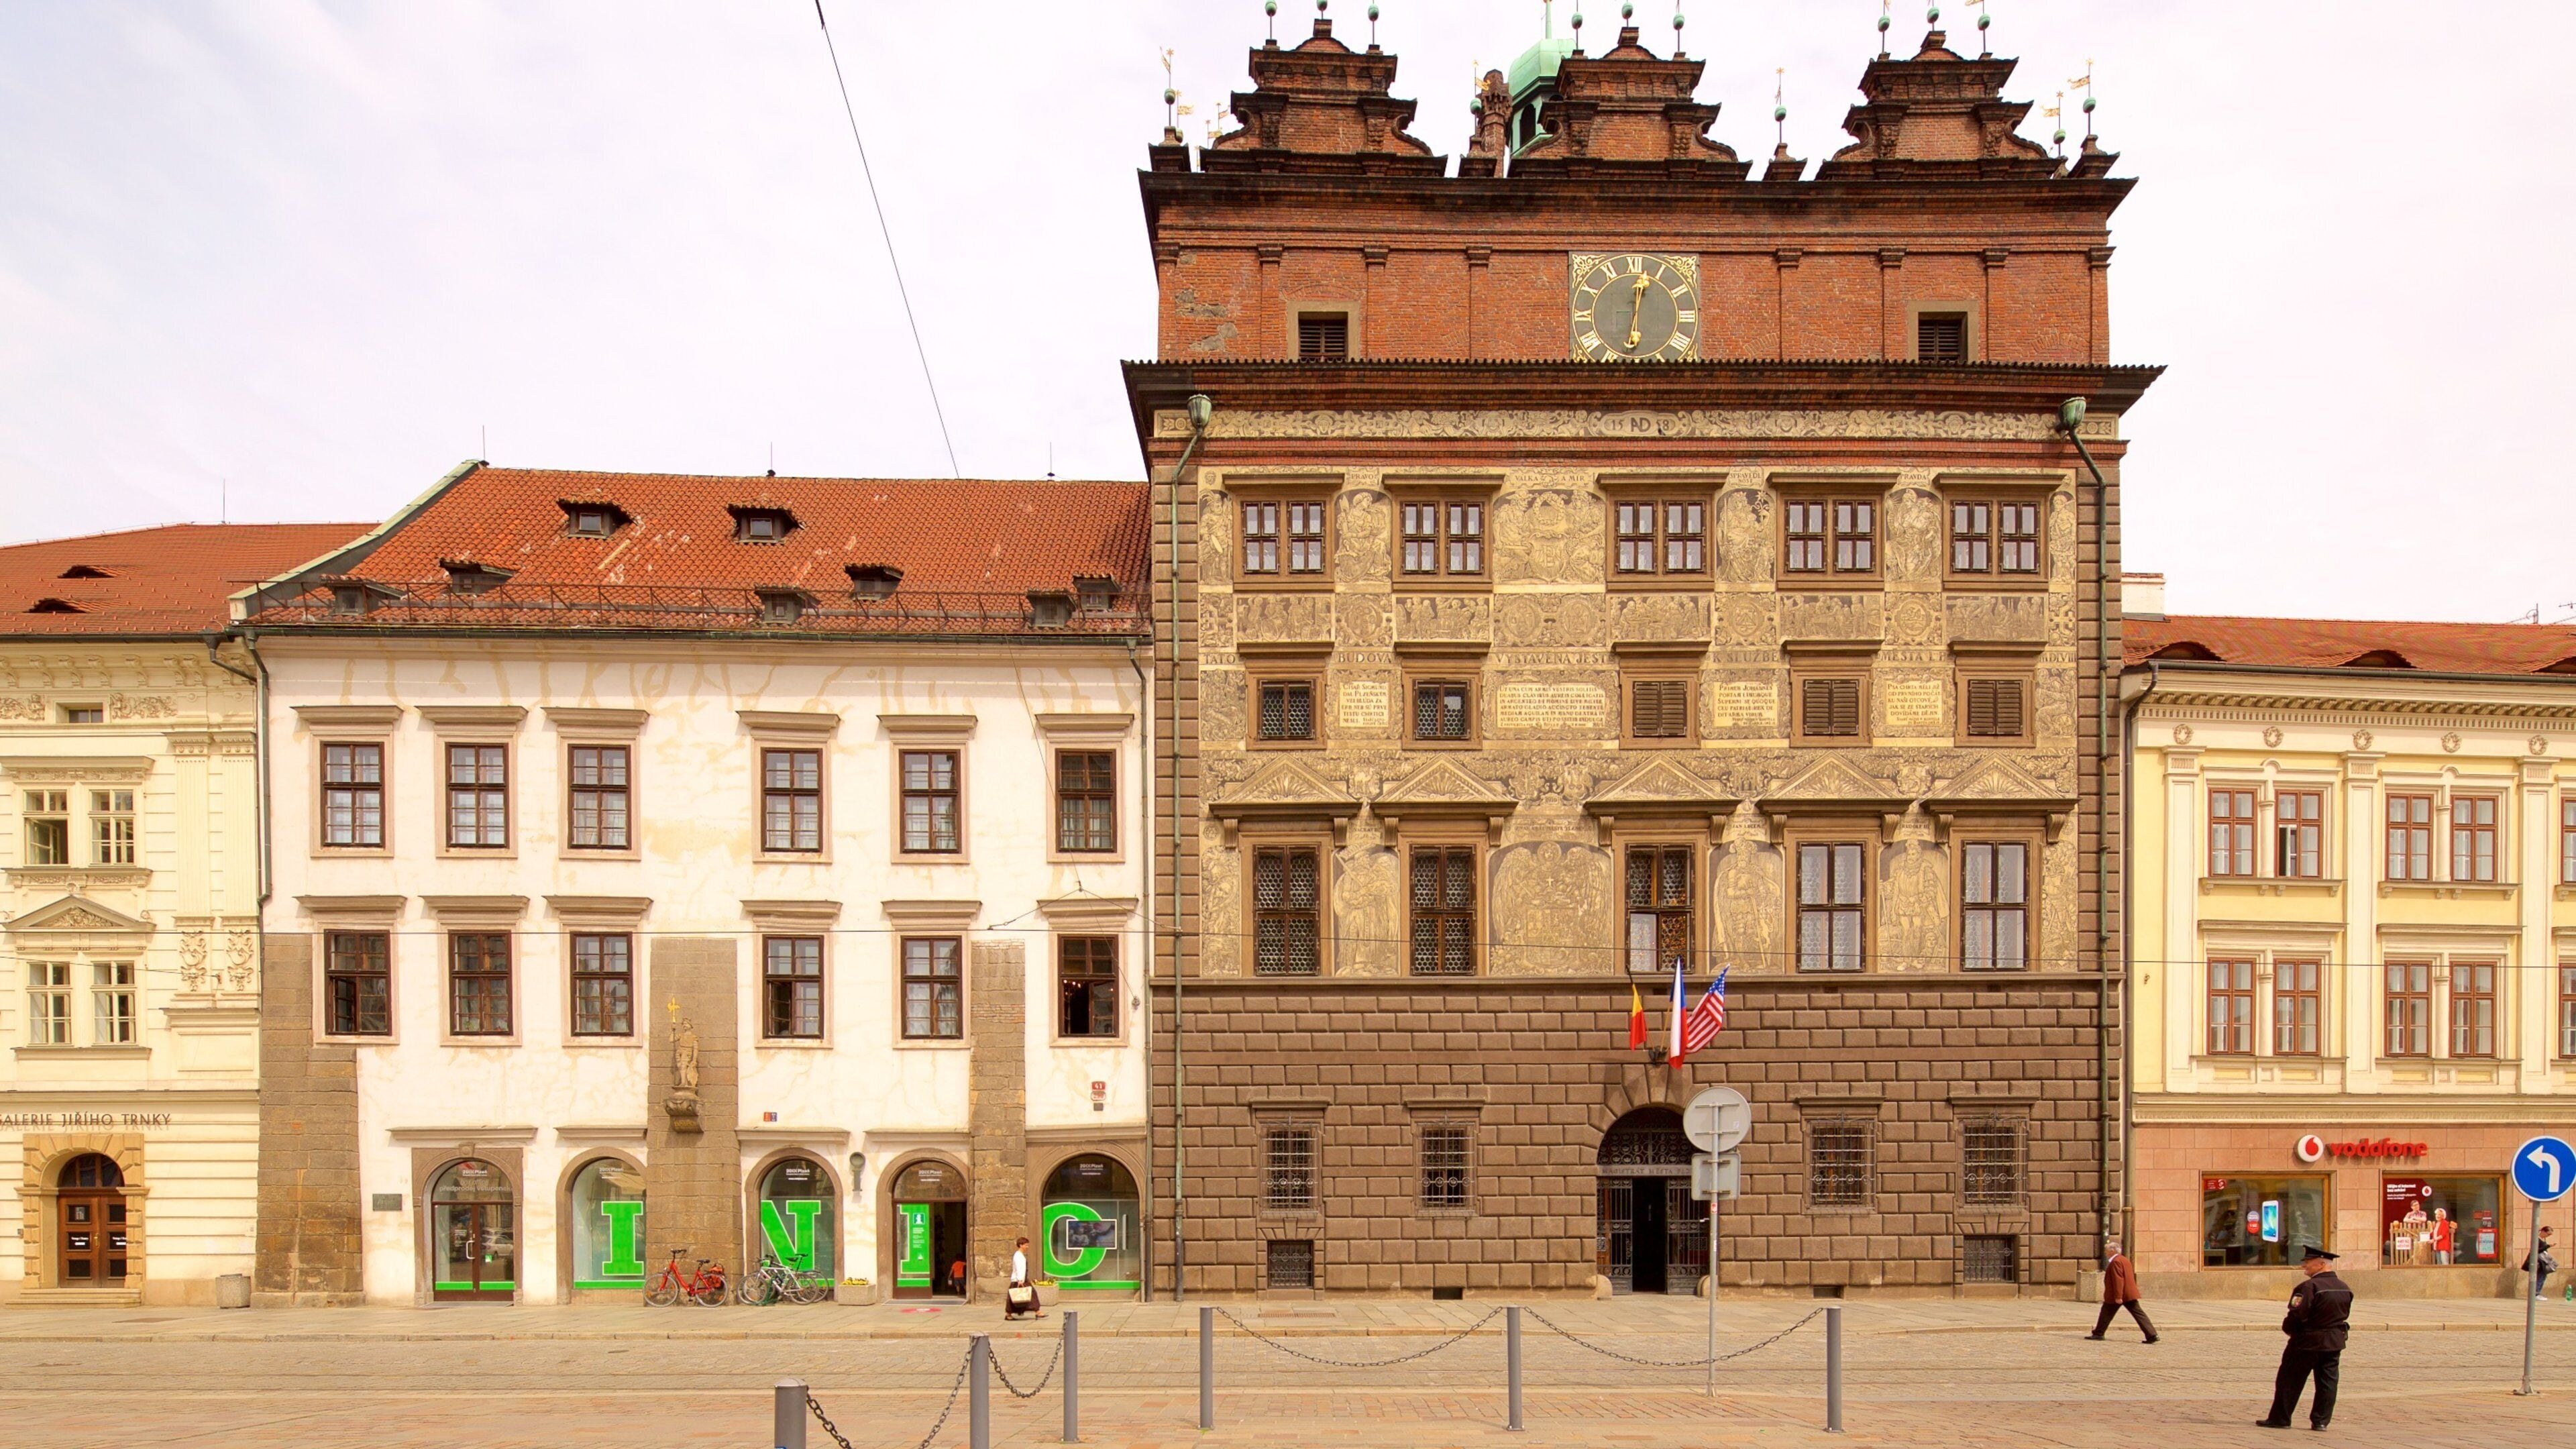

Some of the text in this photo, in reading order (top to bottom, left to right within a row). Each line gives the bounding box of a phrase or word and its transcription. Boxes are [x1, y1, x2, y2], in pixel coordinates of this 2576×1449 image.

[1626, 257, 1642, 273] XII
[1655, 264, 1666, 280] I
[1671, 284, 1688, 298] II
[1678, 310, 1695, 323] III
[1611, 419, 1623, 430] 15
[1631, 417, 1651, 432] AD
[1203, 653, 1236, 664] TATO
[1338, 653, 1392, 663] BUDOVA
[1576, 652, 1606, 663] JEST
[1713, 652, 1721, 663] K
[0, 1112, 170, 1127] ALERIE JIŘÍHO TRNKY
[2330, 1138, 2427, 1157] vodafone
